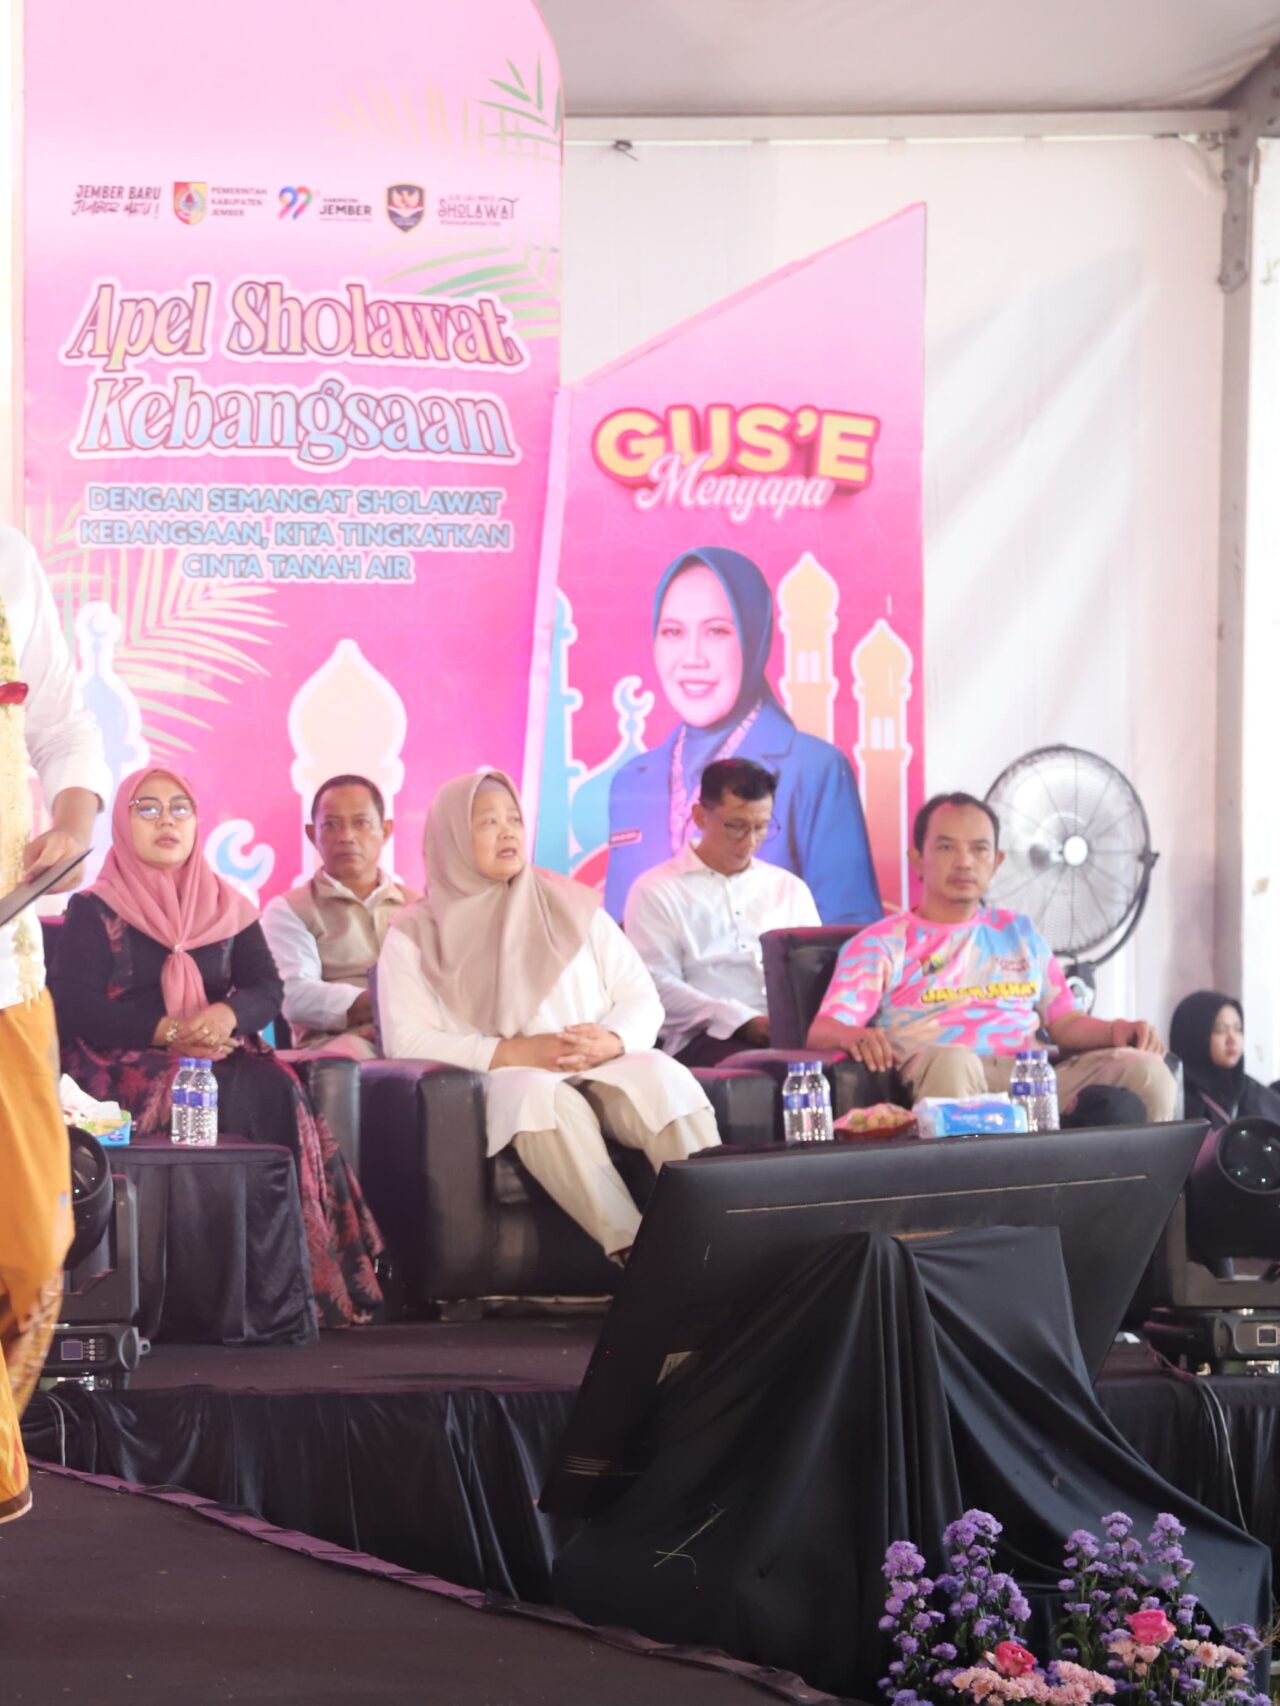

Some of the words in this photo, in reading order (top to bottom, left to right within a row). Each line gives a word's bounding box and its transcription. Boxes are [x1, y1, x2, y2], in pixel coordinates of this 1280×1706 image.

[76, 184, 124, 199] JEMBER
[128, 185, 161, 200] BARU
[211, 187, 267, 195] PEMERINTAH
[211, 198, 263, 206] KABUPATEN
[211, 209, 244, 217] JEMBER
[319, 204, 372, 216] JEMBER
[65, 280, 211, 372] Apel
[227, 280, 524, 367] Sholawat
[76, 376, 516, 465] Kebangsaan
[634, 451, 835, 522] Menyapa
[88, 486, 203, 512] DENGAN
[207, 488, 354, 514] SEMANGAT
[357, 490, 503, 516] SHOLAWAT
[80, 520, 270, 549] KEBANGSAAN,
[274, 521, 334, 547] KITA
[338, 522, 510, 549] TINGKATKAN
[182, 554, 263, 579] CINTA
[267, 554, 363, 580] TANAH
[366, 555, 412, 581] AIR
